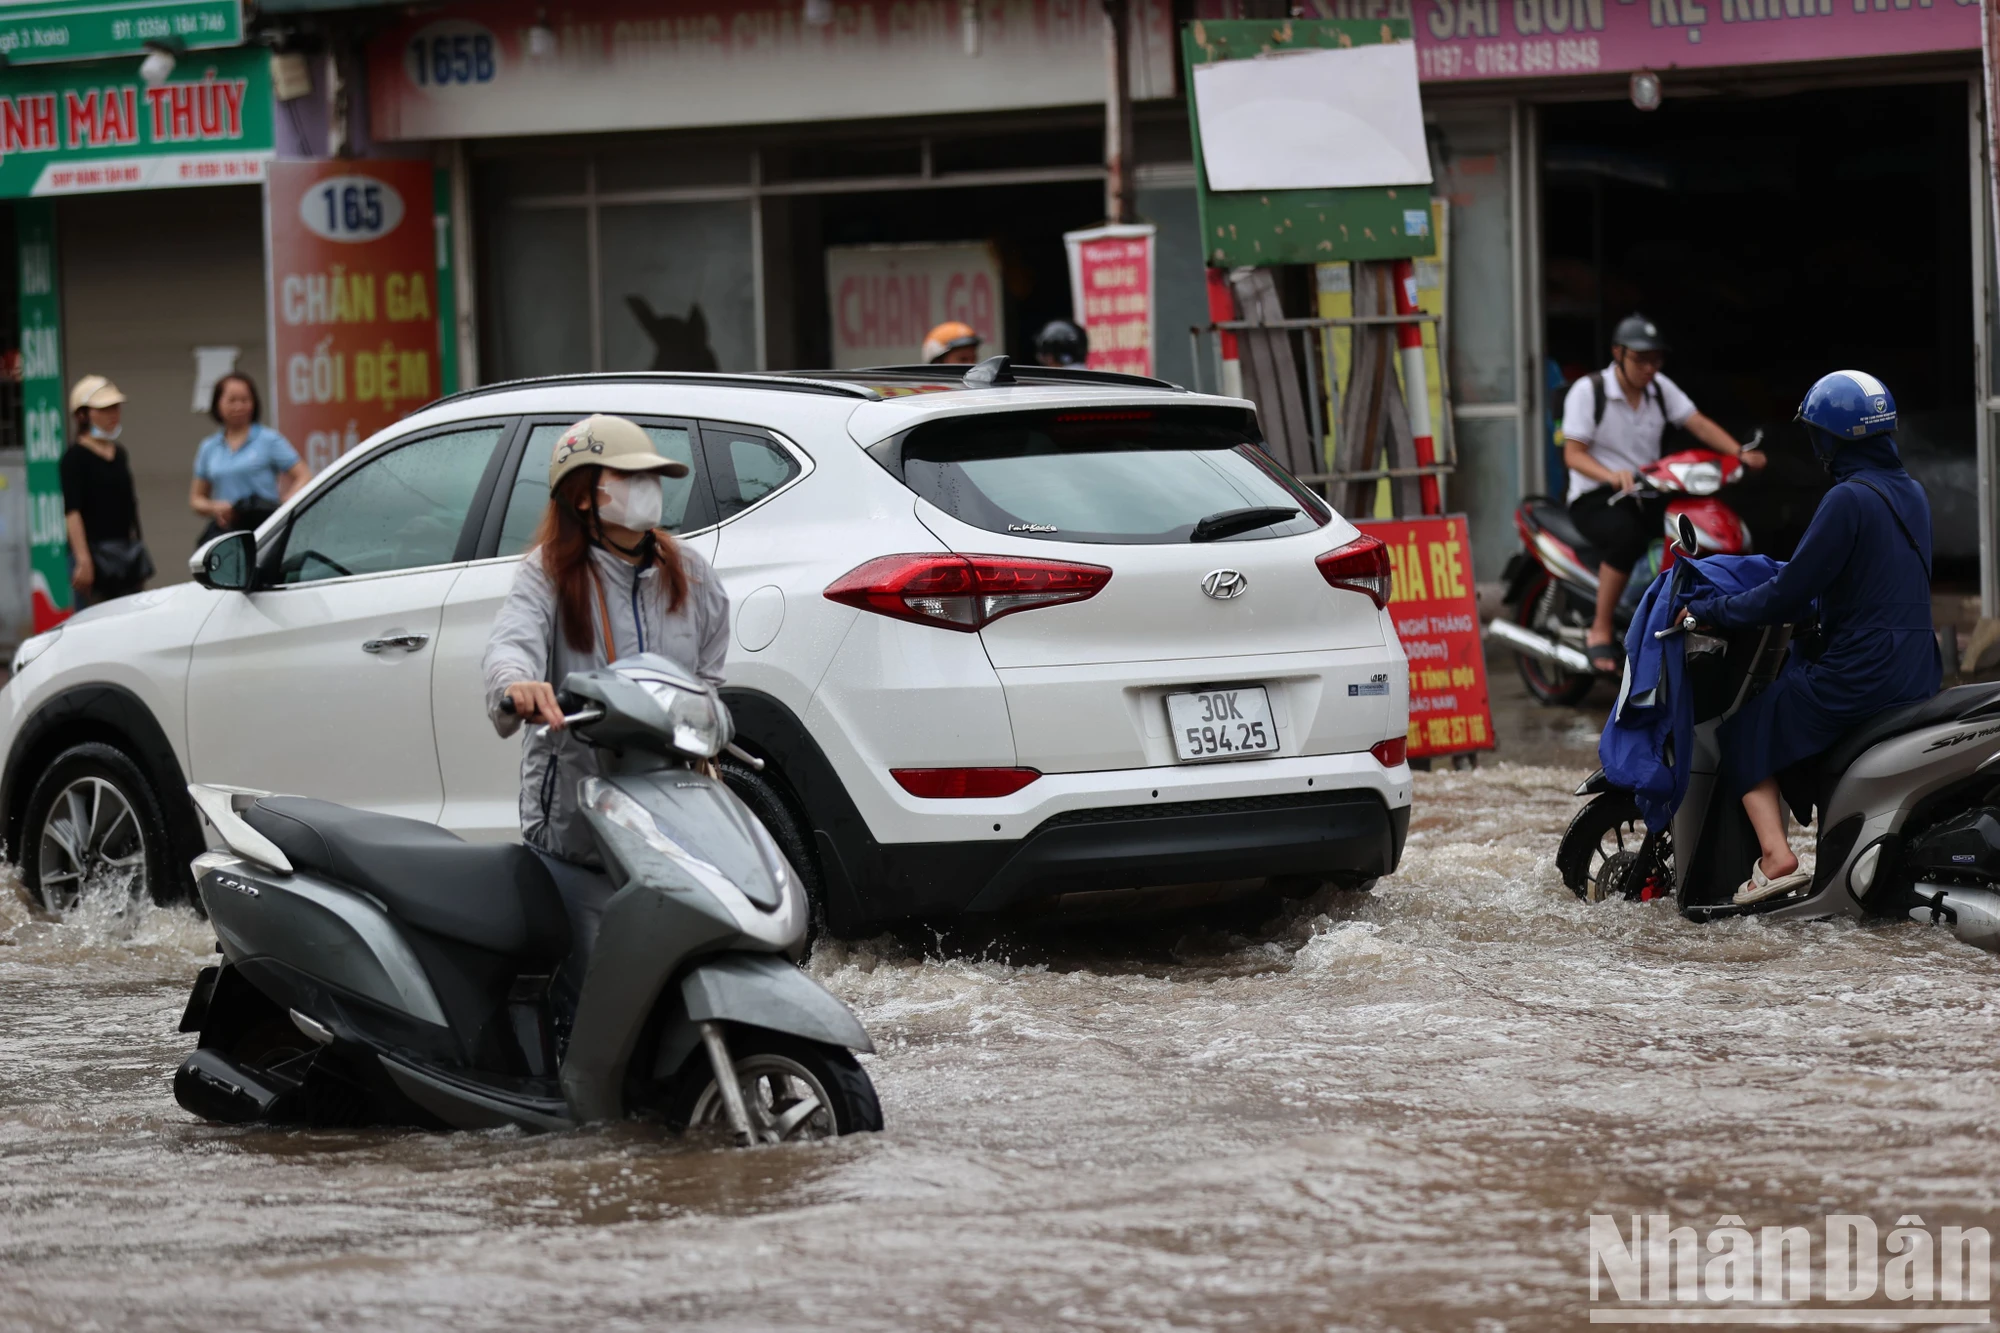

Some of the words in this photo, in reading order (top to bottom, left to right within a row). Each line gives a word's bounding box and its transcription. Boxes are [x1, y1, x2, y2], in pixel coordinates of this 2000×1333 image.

[410, 35, 496, 86] 165B
[0, 94, 60, 153] NH
[65, 86, 140, 148] MAI
[322, 187, 384, 231] 165
[283, 265, 377, 325] CHĂN
[385, 272, 430, 322] GA
[945, 270, 996, 345] GA
[287, 334, 347, 405] GỐI
[354, 340, 430, 412] ĐỆM
[1428, 520, 1466, 600] RẺ
[1198, 692, 1243, 722] 30K
[1186, 721, 1267, 755] 594.25
[216, 876, 259, 896] LEAD
